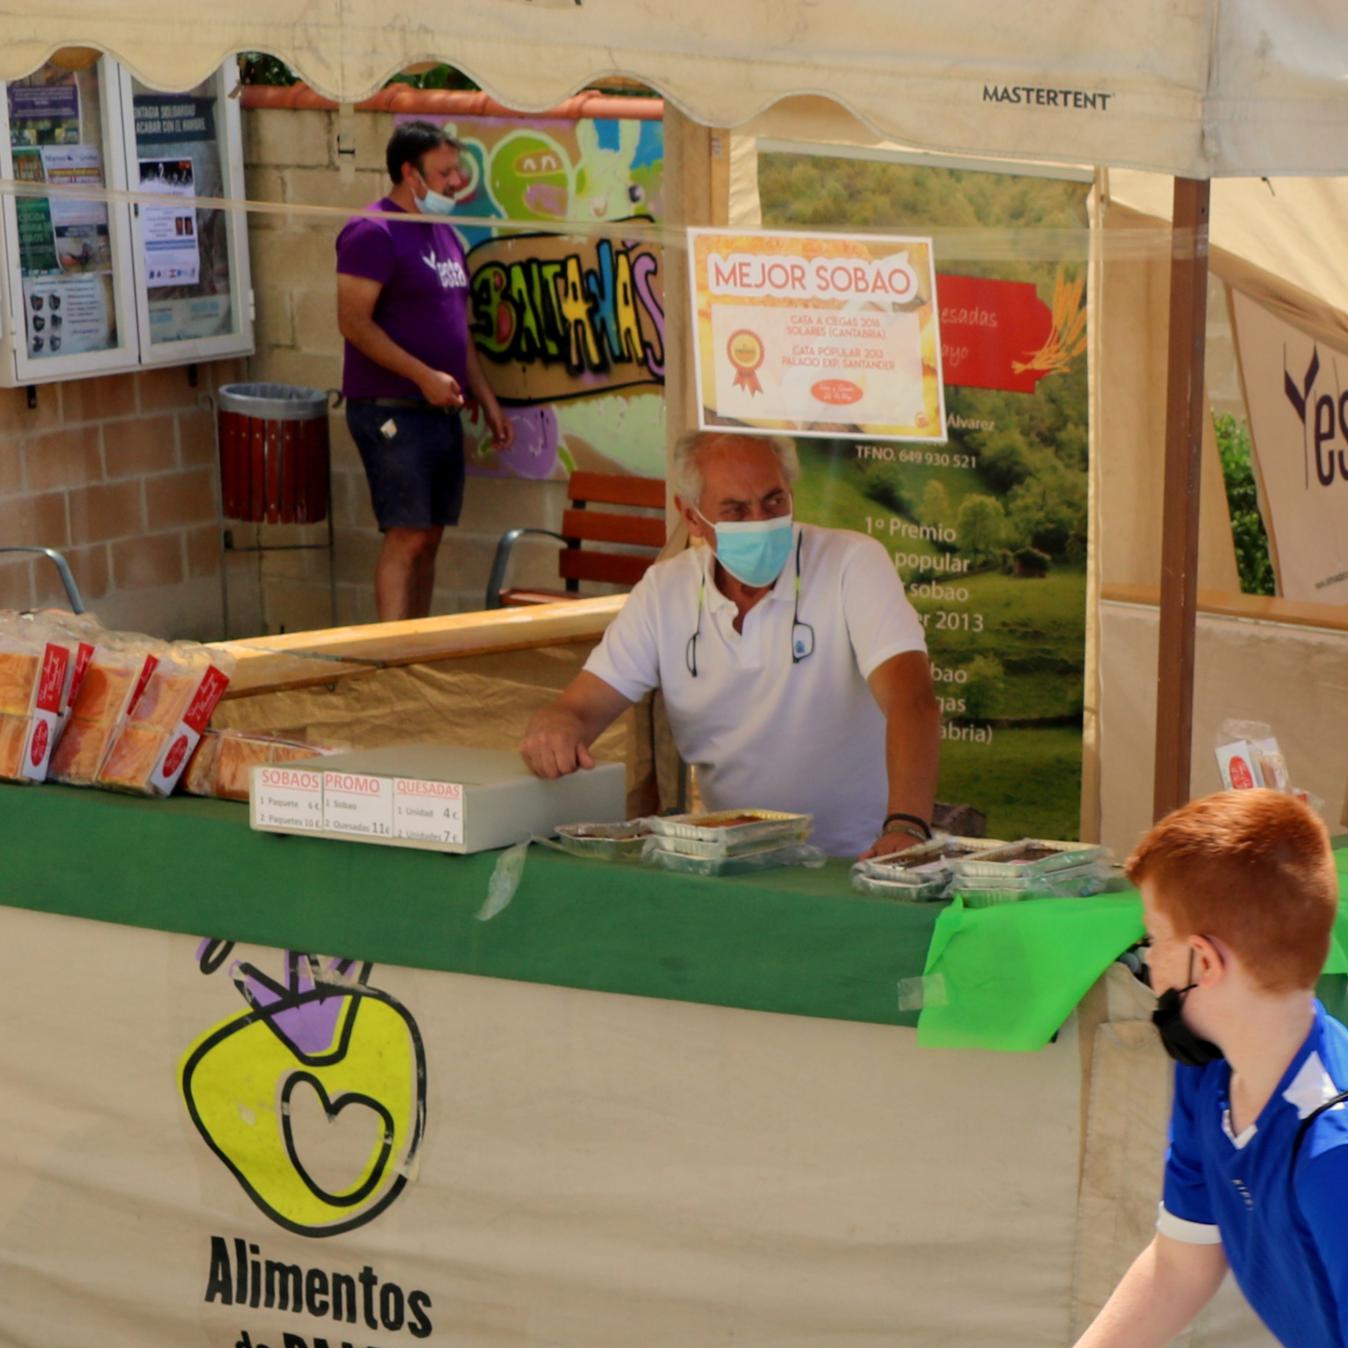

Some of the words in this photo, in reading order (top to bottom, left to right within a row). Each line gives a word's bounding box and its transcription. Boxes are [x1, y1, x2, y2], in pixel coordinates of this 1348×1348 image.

[983, 85, 1111, 111] MASTERTENT
[714, 262, 806, 290] MEJOR
[815, 265, 911, 295] SOBAO
[899, 448, 922, 464] 649
[925, 452, 949, 467] 930
[953, 454, 977, 469] 521
[890, 517, 956, 543] Premio
[895, 551, 970, 574] popular
[911, 580, 969, 603] sobao
[936, 611, 984, 633] 2013
[262, 769, 319, 788] SOBAOS
[325, 774, 380, 793] PROMO
[397, 780, 460, 798] QUESADAS
[204, 1235, 433, 1339] Alimentos
